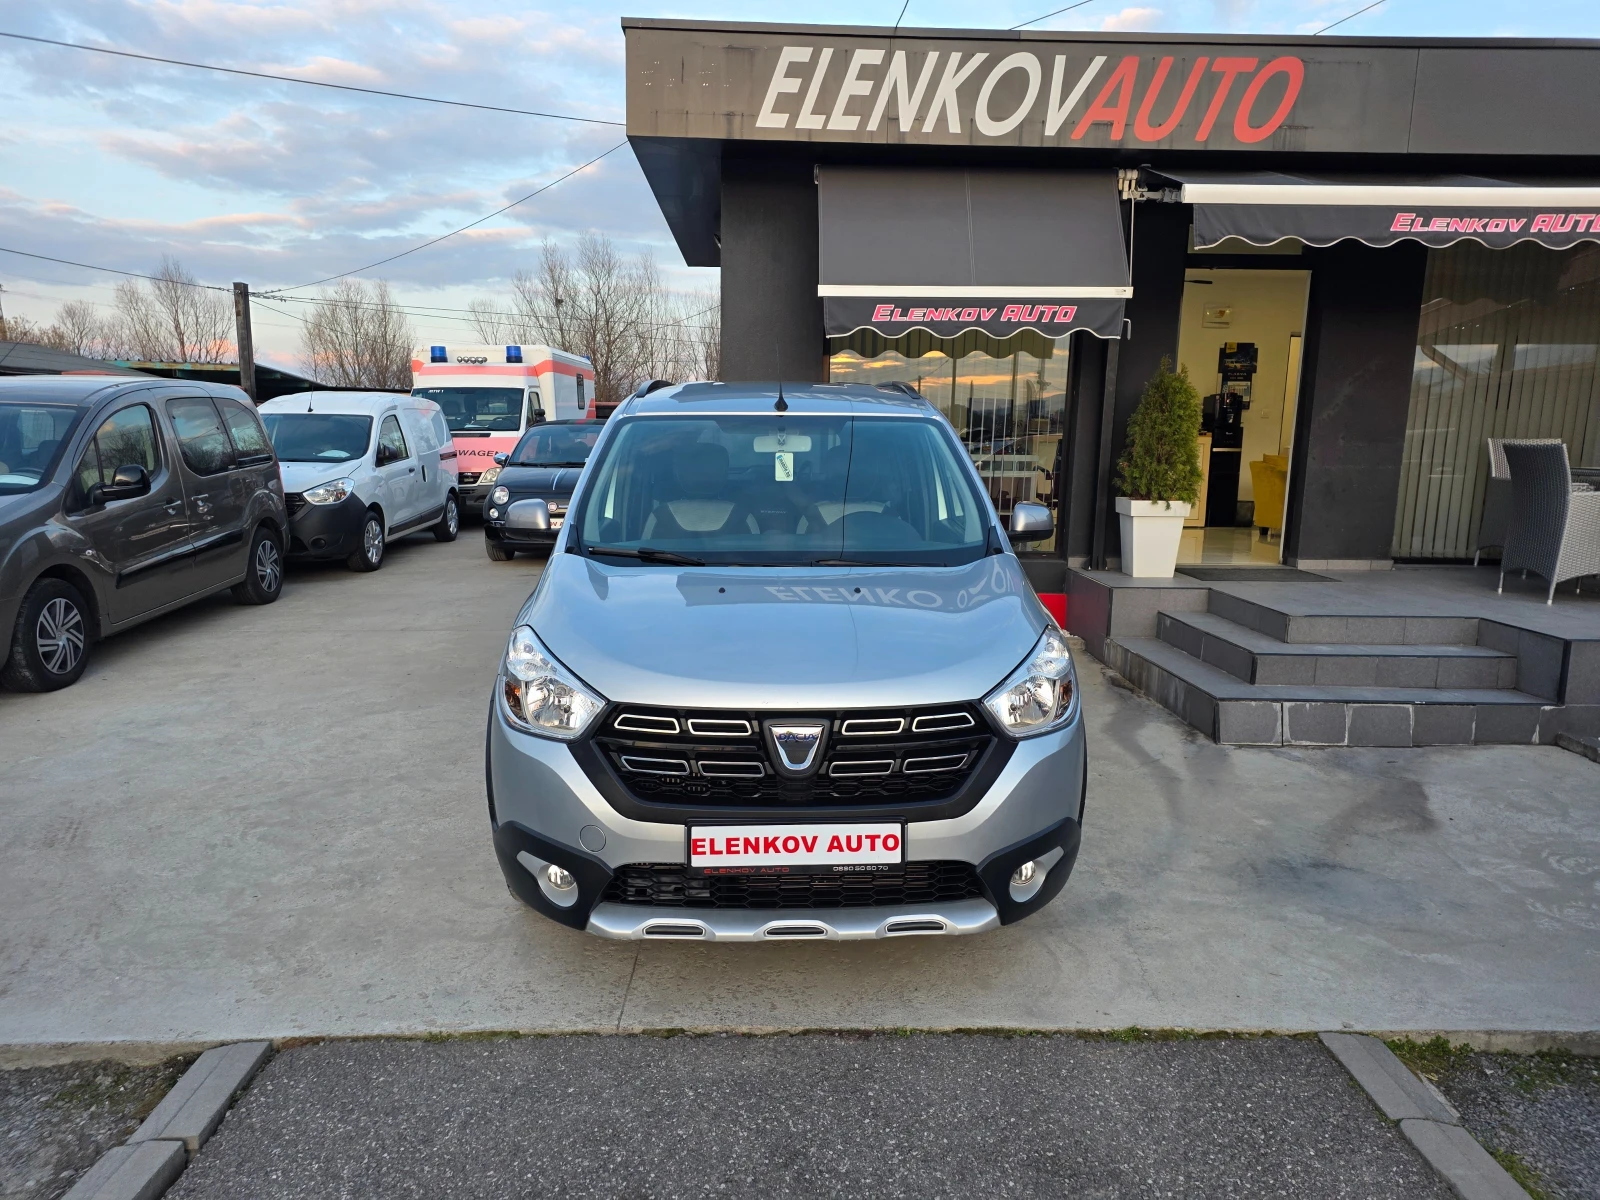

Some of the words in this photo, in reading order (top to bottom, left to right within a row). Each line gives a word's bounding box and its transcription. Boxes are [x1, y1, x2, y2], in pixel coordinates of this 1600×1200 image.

[756, 46, 1107, 137] ELENKOV
[1071, 56, 1305, 143] AUTO
[1391, 213, 1526, 233] ELENKOV
[872, 304, 997, 322] ELENKOV
[1000, 304, 1078, 322] AUTO
[779, 733, 816, 742] DACIA
[691, 836, 819, 855] ELENKOV
[826, 834, 900, 852] AUTO
